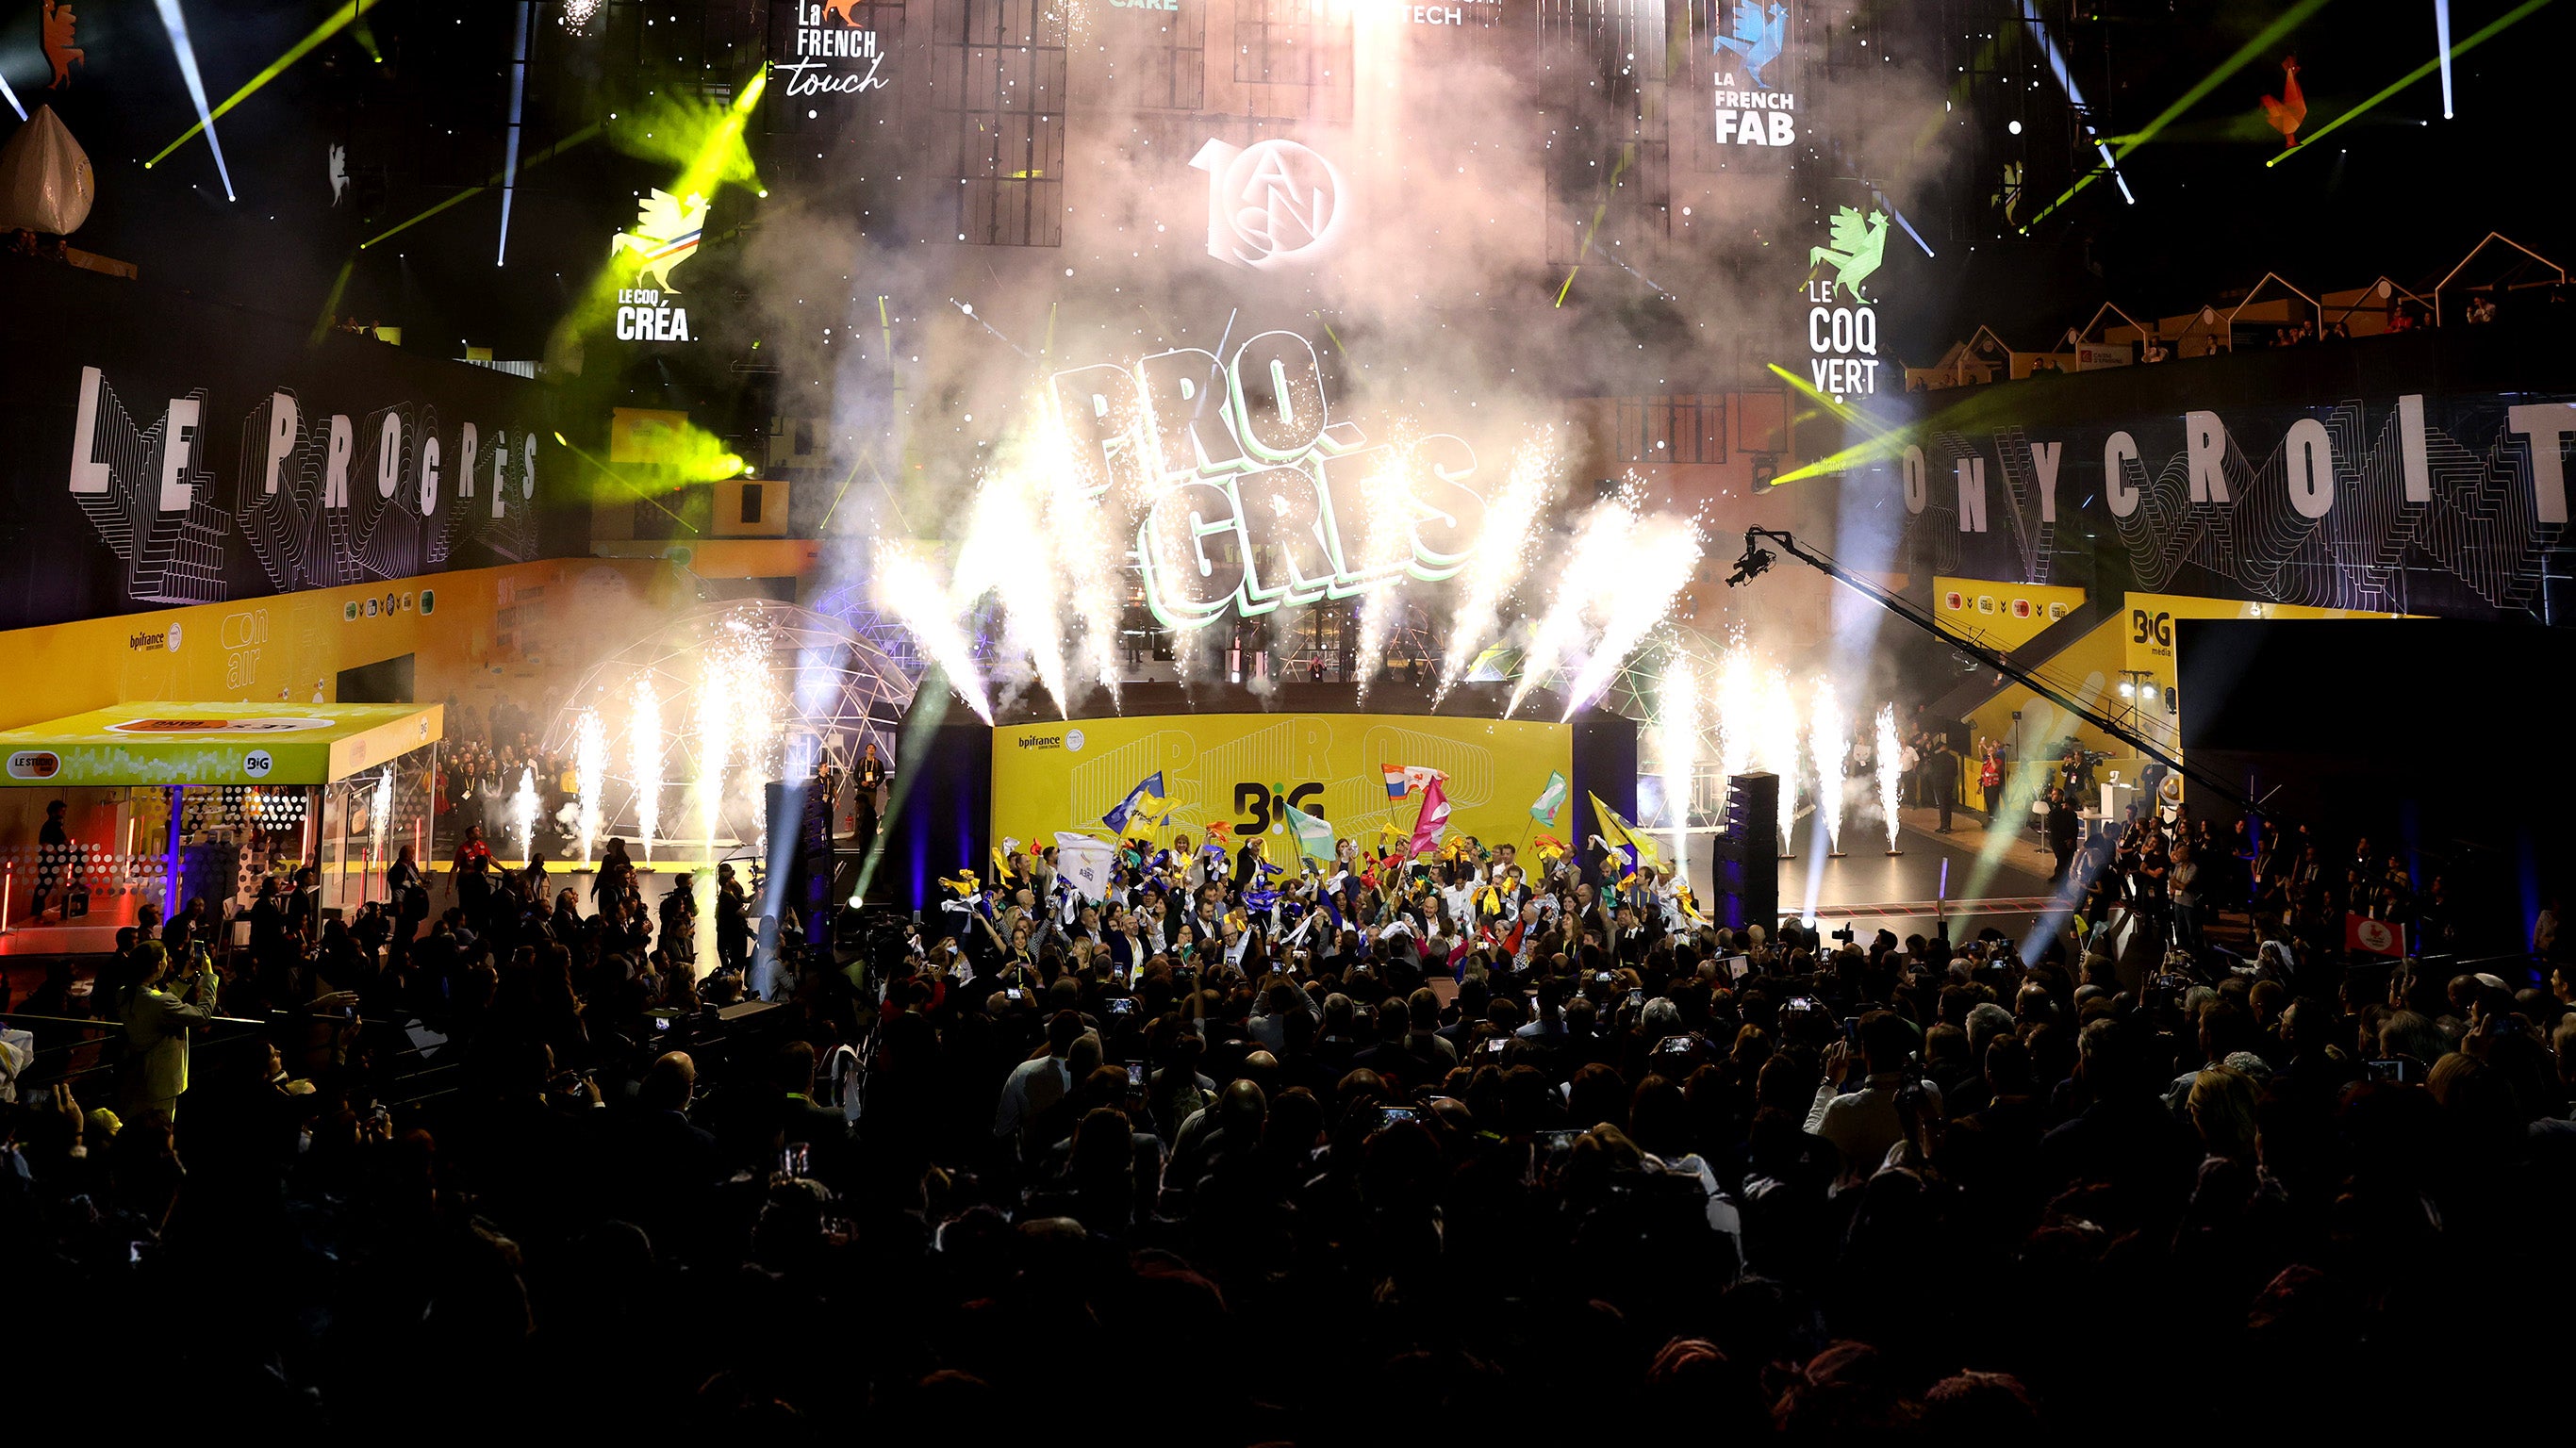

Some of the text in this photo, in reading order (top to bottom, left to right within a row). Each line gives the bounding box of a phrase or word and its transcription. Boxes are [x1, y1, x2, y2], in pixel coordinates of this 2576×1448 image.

[798, 0, 821, 26] La
[1402, 5, 1461, 25] TECH
[797, 28, 877, 58] FRENCH
[773, 51, 889, 97] touch
[1713, 72, 1735, 87] LA
[1714, 90, 1794, 110] FRENCH
[1714, 109, 1796, 147] FAB
[618, 288, 659, 307] LE COQ
[1808, 280, 1832, 304] LE
[616, 299, 690, 342] CRÉA
[1808, 306, 1877, 356] COQ
[1810, 358, 1880, 394] VERT
[69, 365, 537, 519] LE PROGRÈS
[130, 631, 164, 650] bpifrance
[1018, 734, 1061, 749] bpifrance
[14, 758, 25, 766] LE
